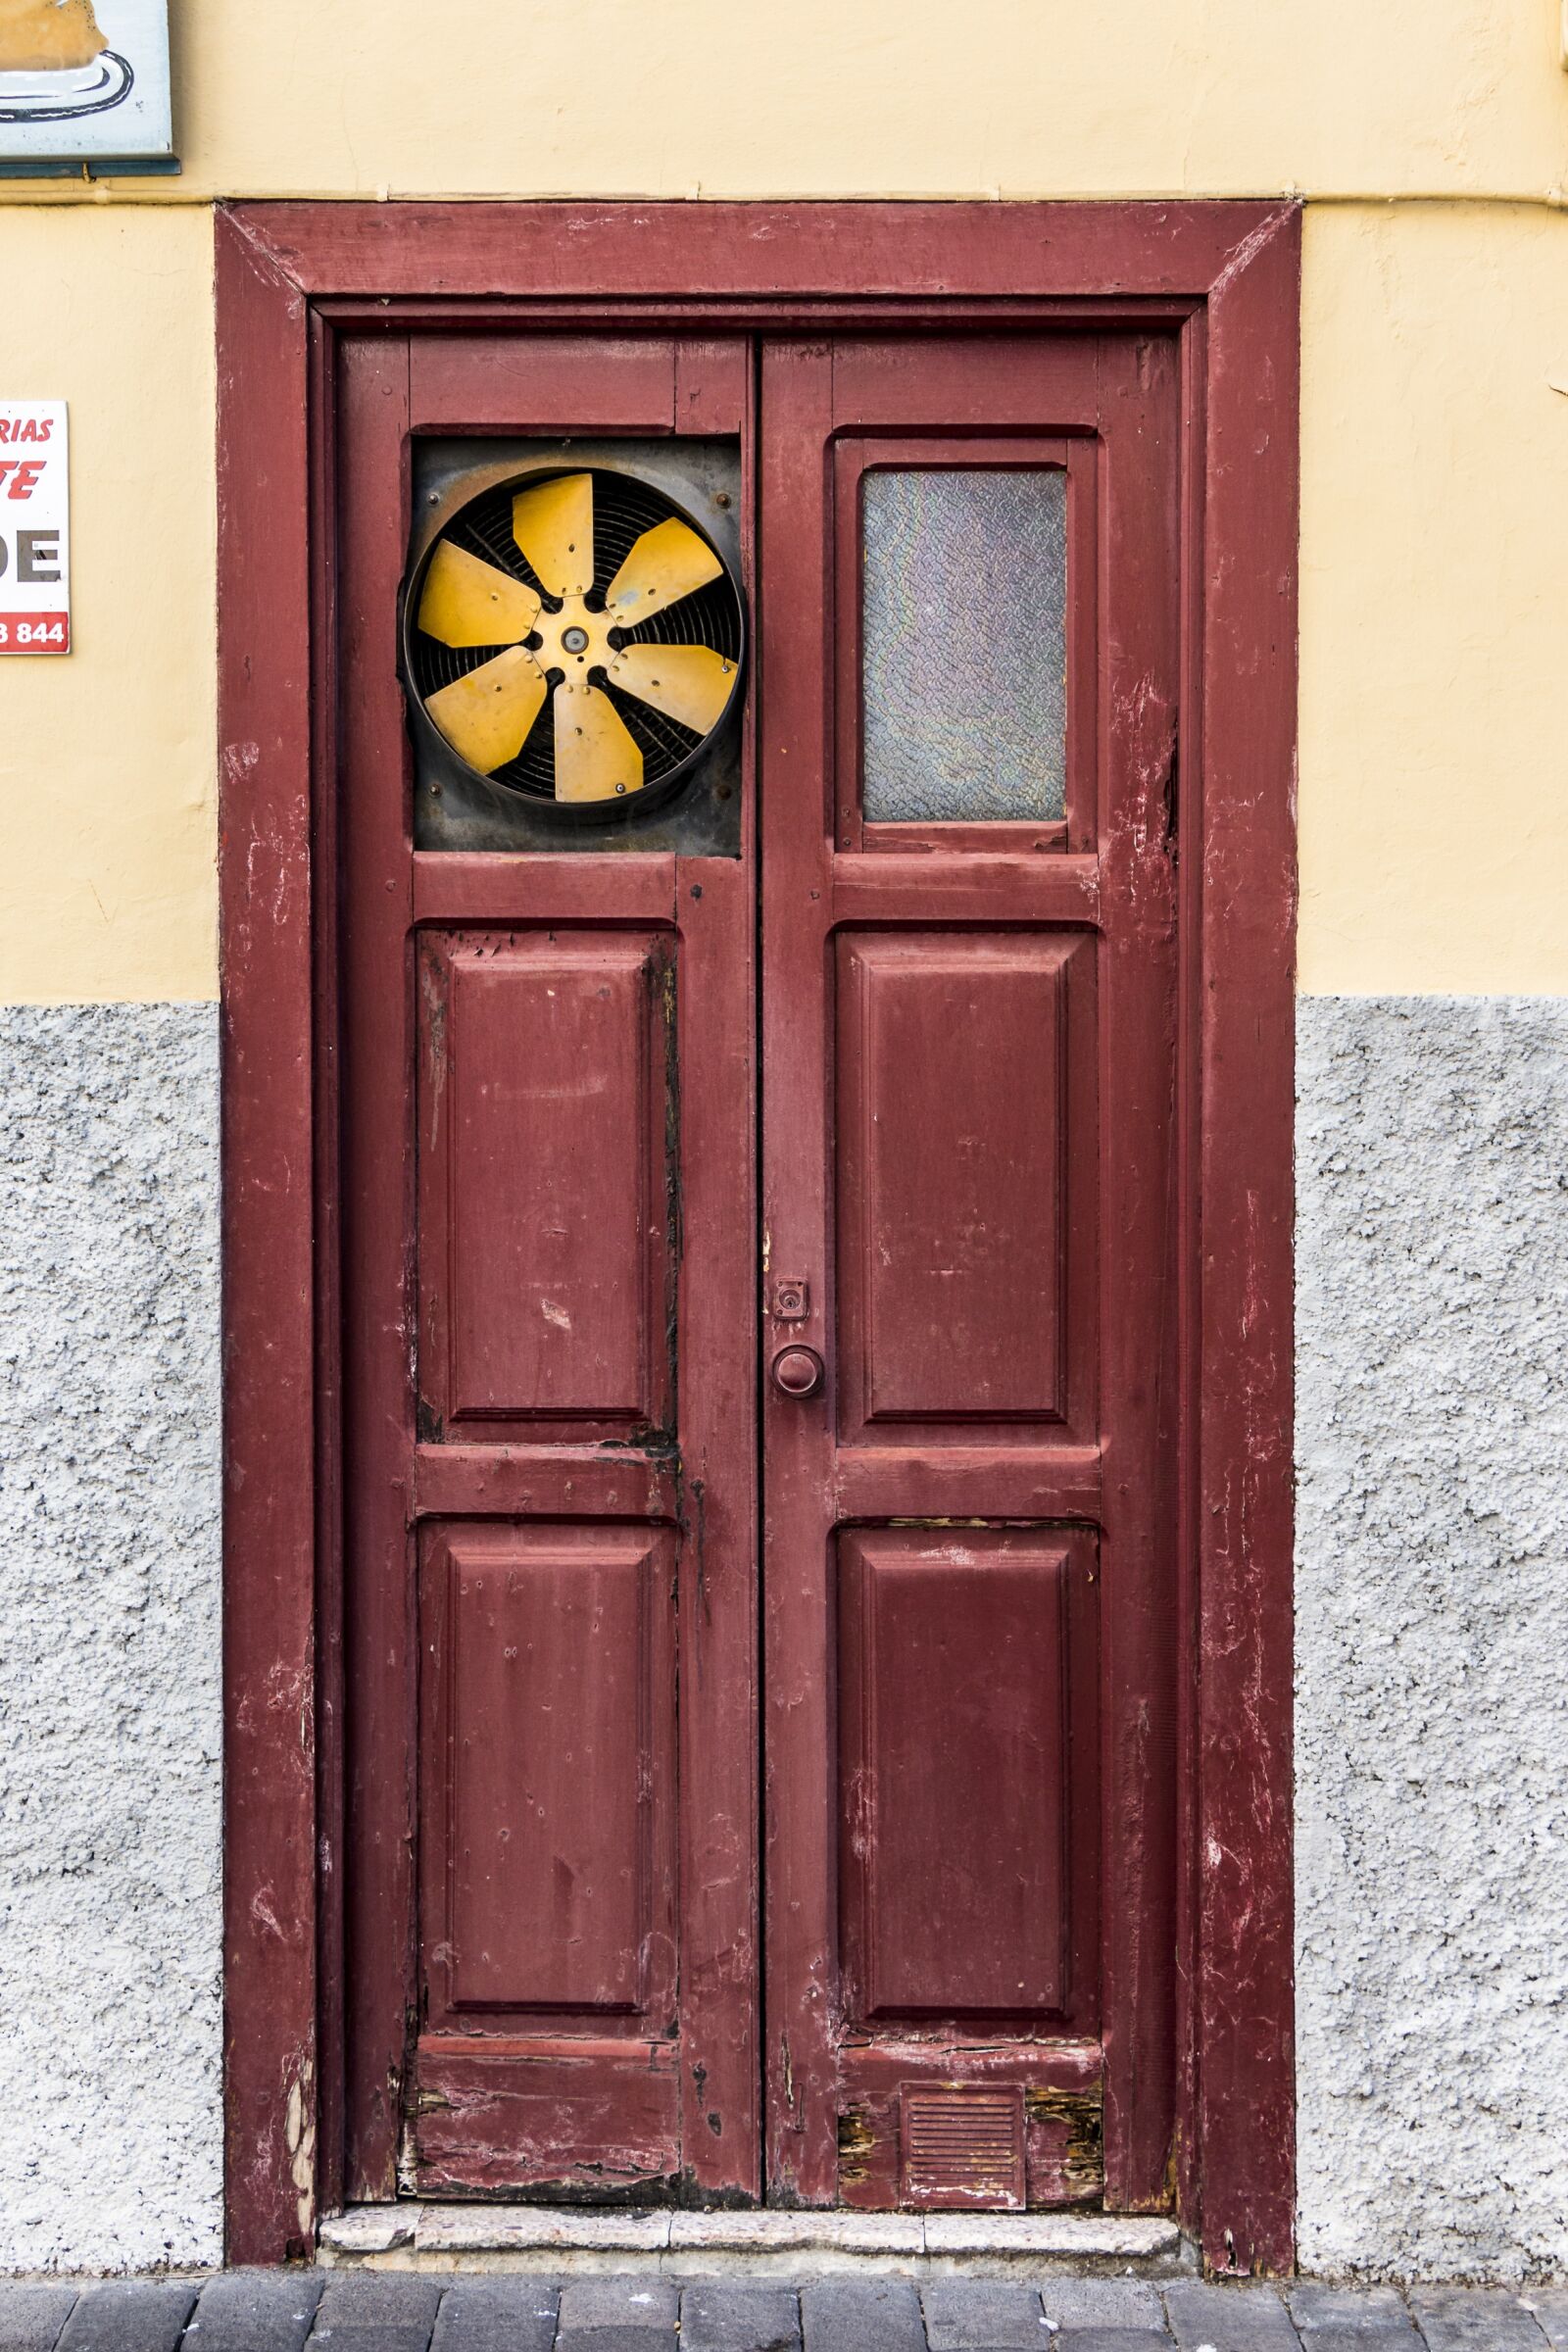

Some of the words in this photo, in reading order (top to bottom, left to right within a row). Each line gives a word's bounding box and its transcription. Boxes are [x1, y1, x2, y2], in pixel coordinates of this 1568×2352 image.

[0, 419, 54, 443] RIAS
[0, 530, 61, 582] E
[17, 622, 65, 643] 844
